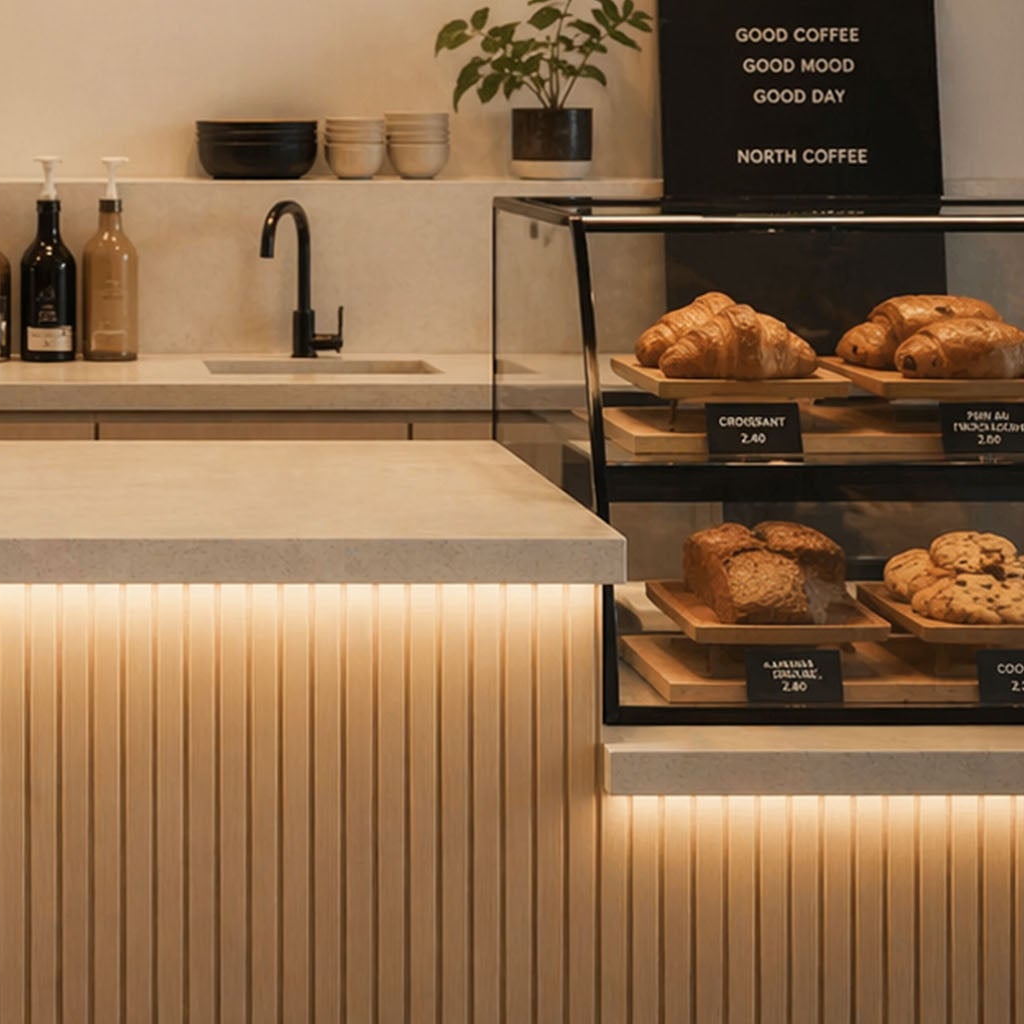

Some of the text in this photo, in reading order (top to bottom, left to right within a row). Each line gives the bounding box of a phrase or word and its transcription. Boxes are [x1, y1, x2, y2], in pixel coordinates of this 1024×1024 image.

[735, 27, 859, 43] GOOD COFFEE
[742, 57, 855, 73] GOOD MOOD
[753, 88, 845, 104] GOOD DAY
[737, 148, 868, 164] NORTH COFFEE
[996, 662, 1024, 675] COO
